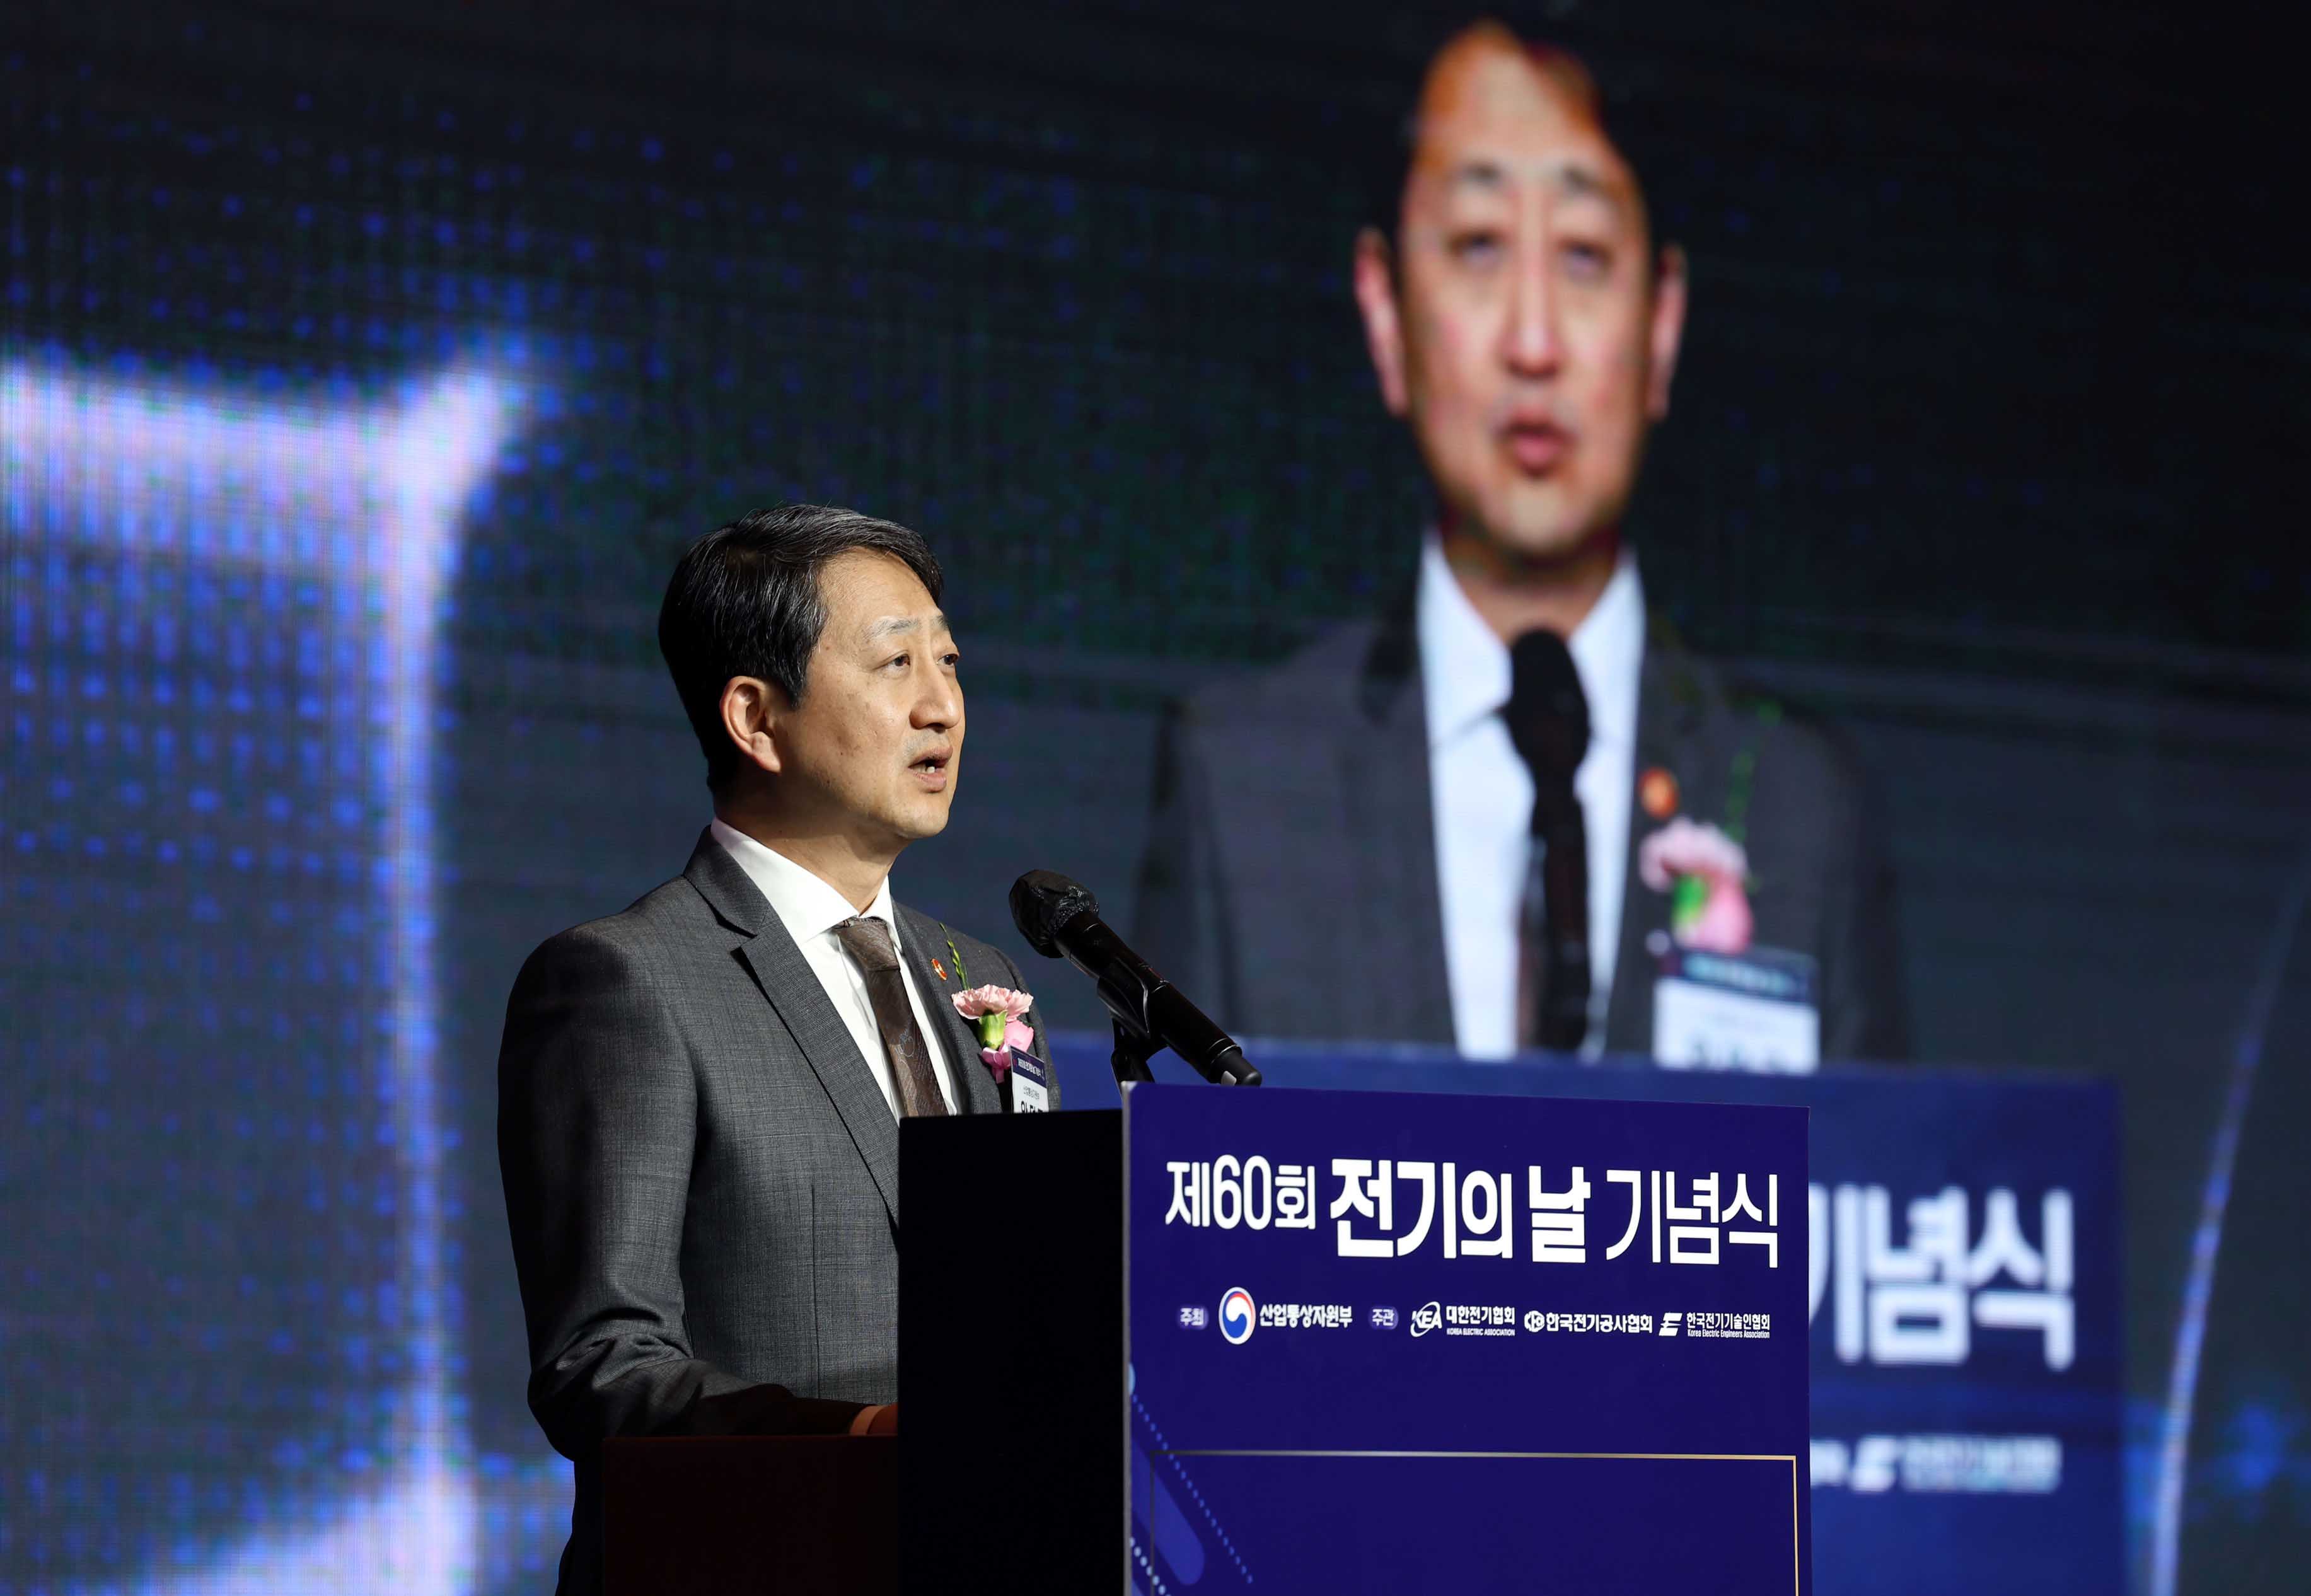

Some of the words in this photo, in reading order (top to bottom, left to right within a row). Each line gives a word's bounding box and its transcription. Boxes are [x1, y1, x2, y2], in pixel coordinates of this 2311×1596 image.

[1165, 1154, 1316, 1230] 제60회
[1330, 1159, 1513, 1259] 전기의
[1529, 1165, 1591, 1263] 날
[1606, 1169, 1778, 1268] 기념식
[1180, 1308, 1205, 1326] 주최
[1260, 1304, 1353, 1328] 산업통상자원부
[1372, 1309, 1394, 1326] 주관
[1411, 1310, 1442, 1329] KEA
[1445, 1305, 1515, 1325] 대한전기협회
[1546, 1312, 1653, 1334] 한국전기공사협회
[1686, 1312, 1770, 1331] 한국전기기술인협회
[1484, 1328, 1515, 1336] ASSOCIATION
[1720, 1329, 1743, 1338] Engineers
[1744, 1330, 1770, 1338] Association
